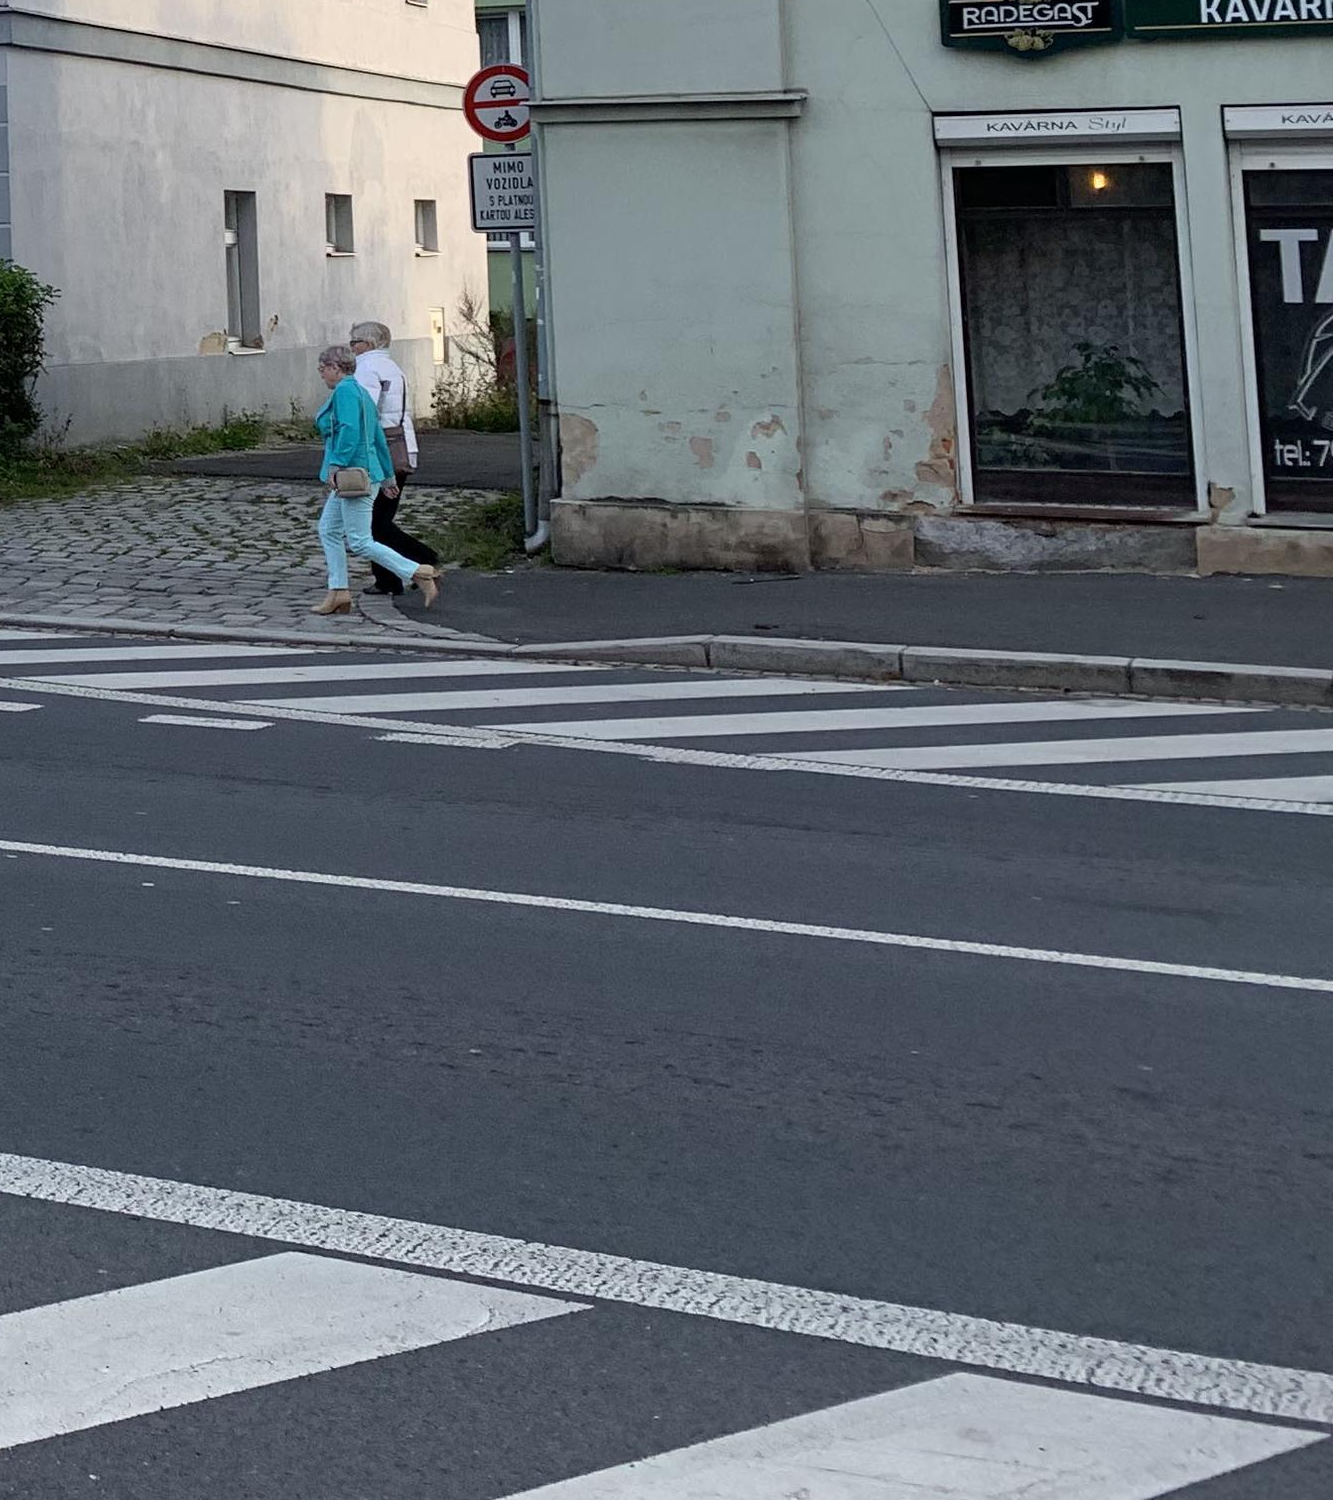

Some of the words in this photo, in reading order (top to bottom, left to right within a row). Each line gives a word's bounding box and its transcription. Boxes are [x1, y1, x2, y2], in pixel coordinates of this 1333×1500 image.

[962, 2, 1099, 29] RADEGAST
[986, 120, 1078, 132] KAVÁRNA
[493, 161, 524, 173] MIMO
[486, 177, 533, 190] VOZIDLA
[489, 195, 495, 206] S
[480, 209, 511, 220] KARTOU
